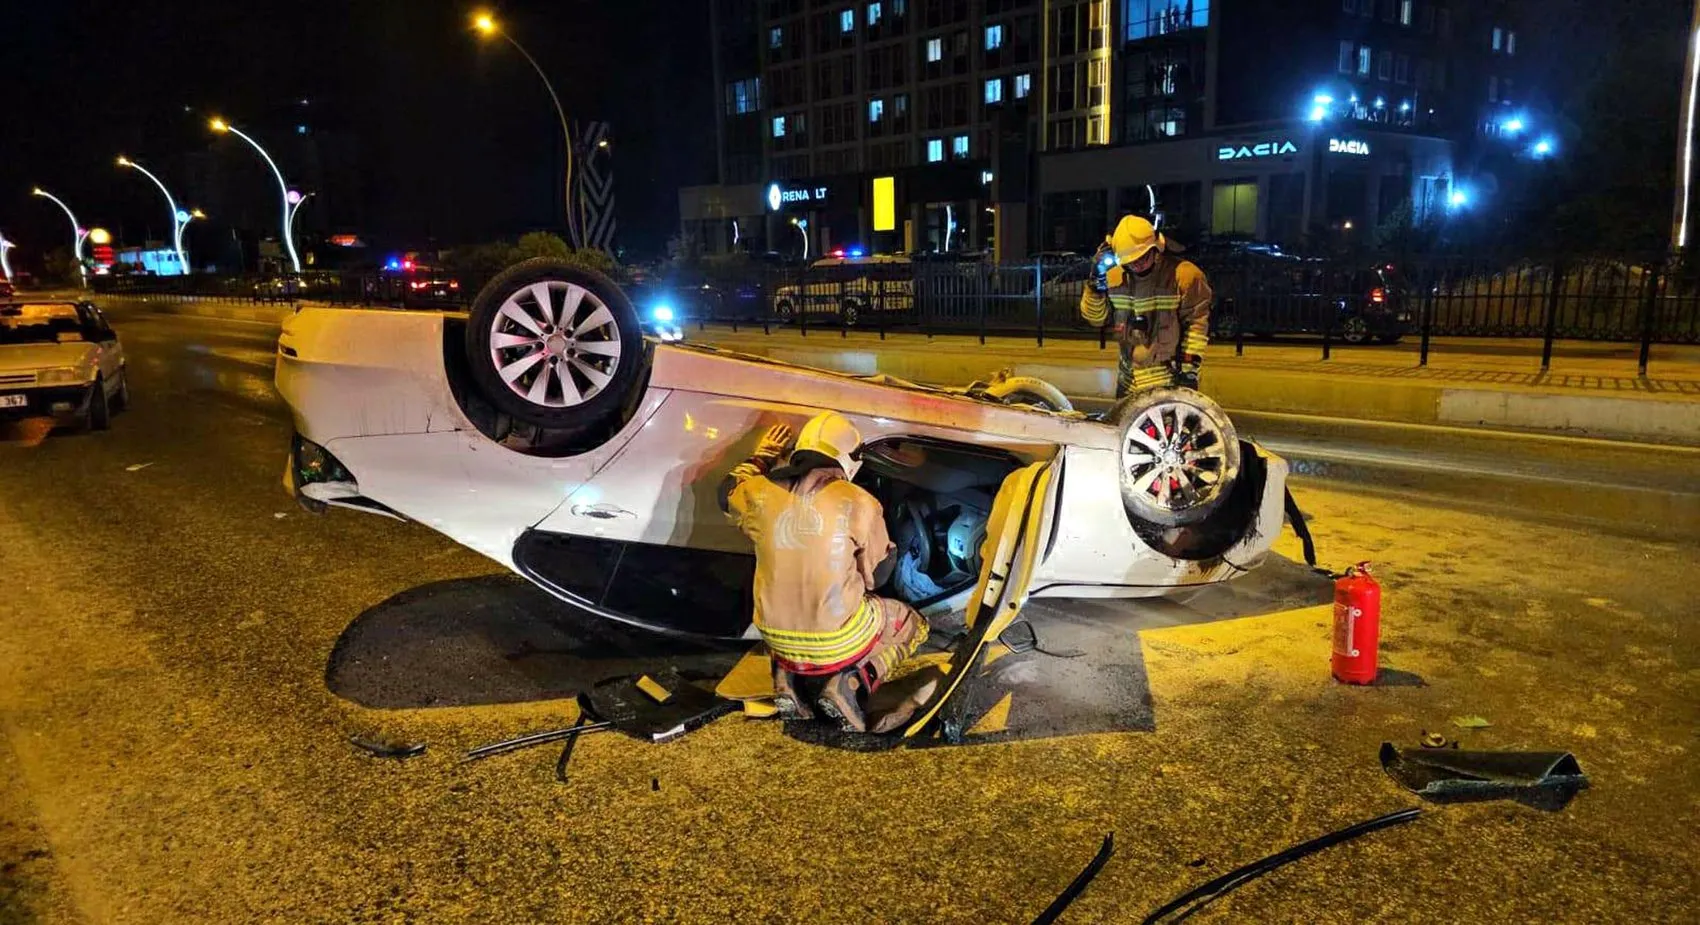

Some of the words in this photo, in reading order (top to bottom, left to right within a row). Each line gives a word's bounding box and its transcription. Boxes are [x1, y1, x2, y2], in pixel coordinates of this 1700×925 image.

[1219, 141, 1297, 159] DACIA
[1329, 138, 1369, 155] DACIA
[782, 187, 827, 202] RENALT
